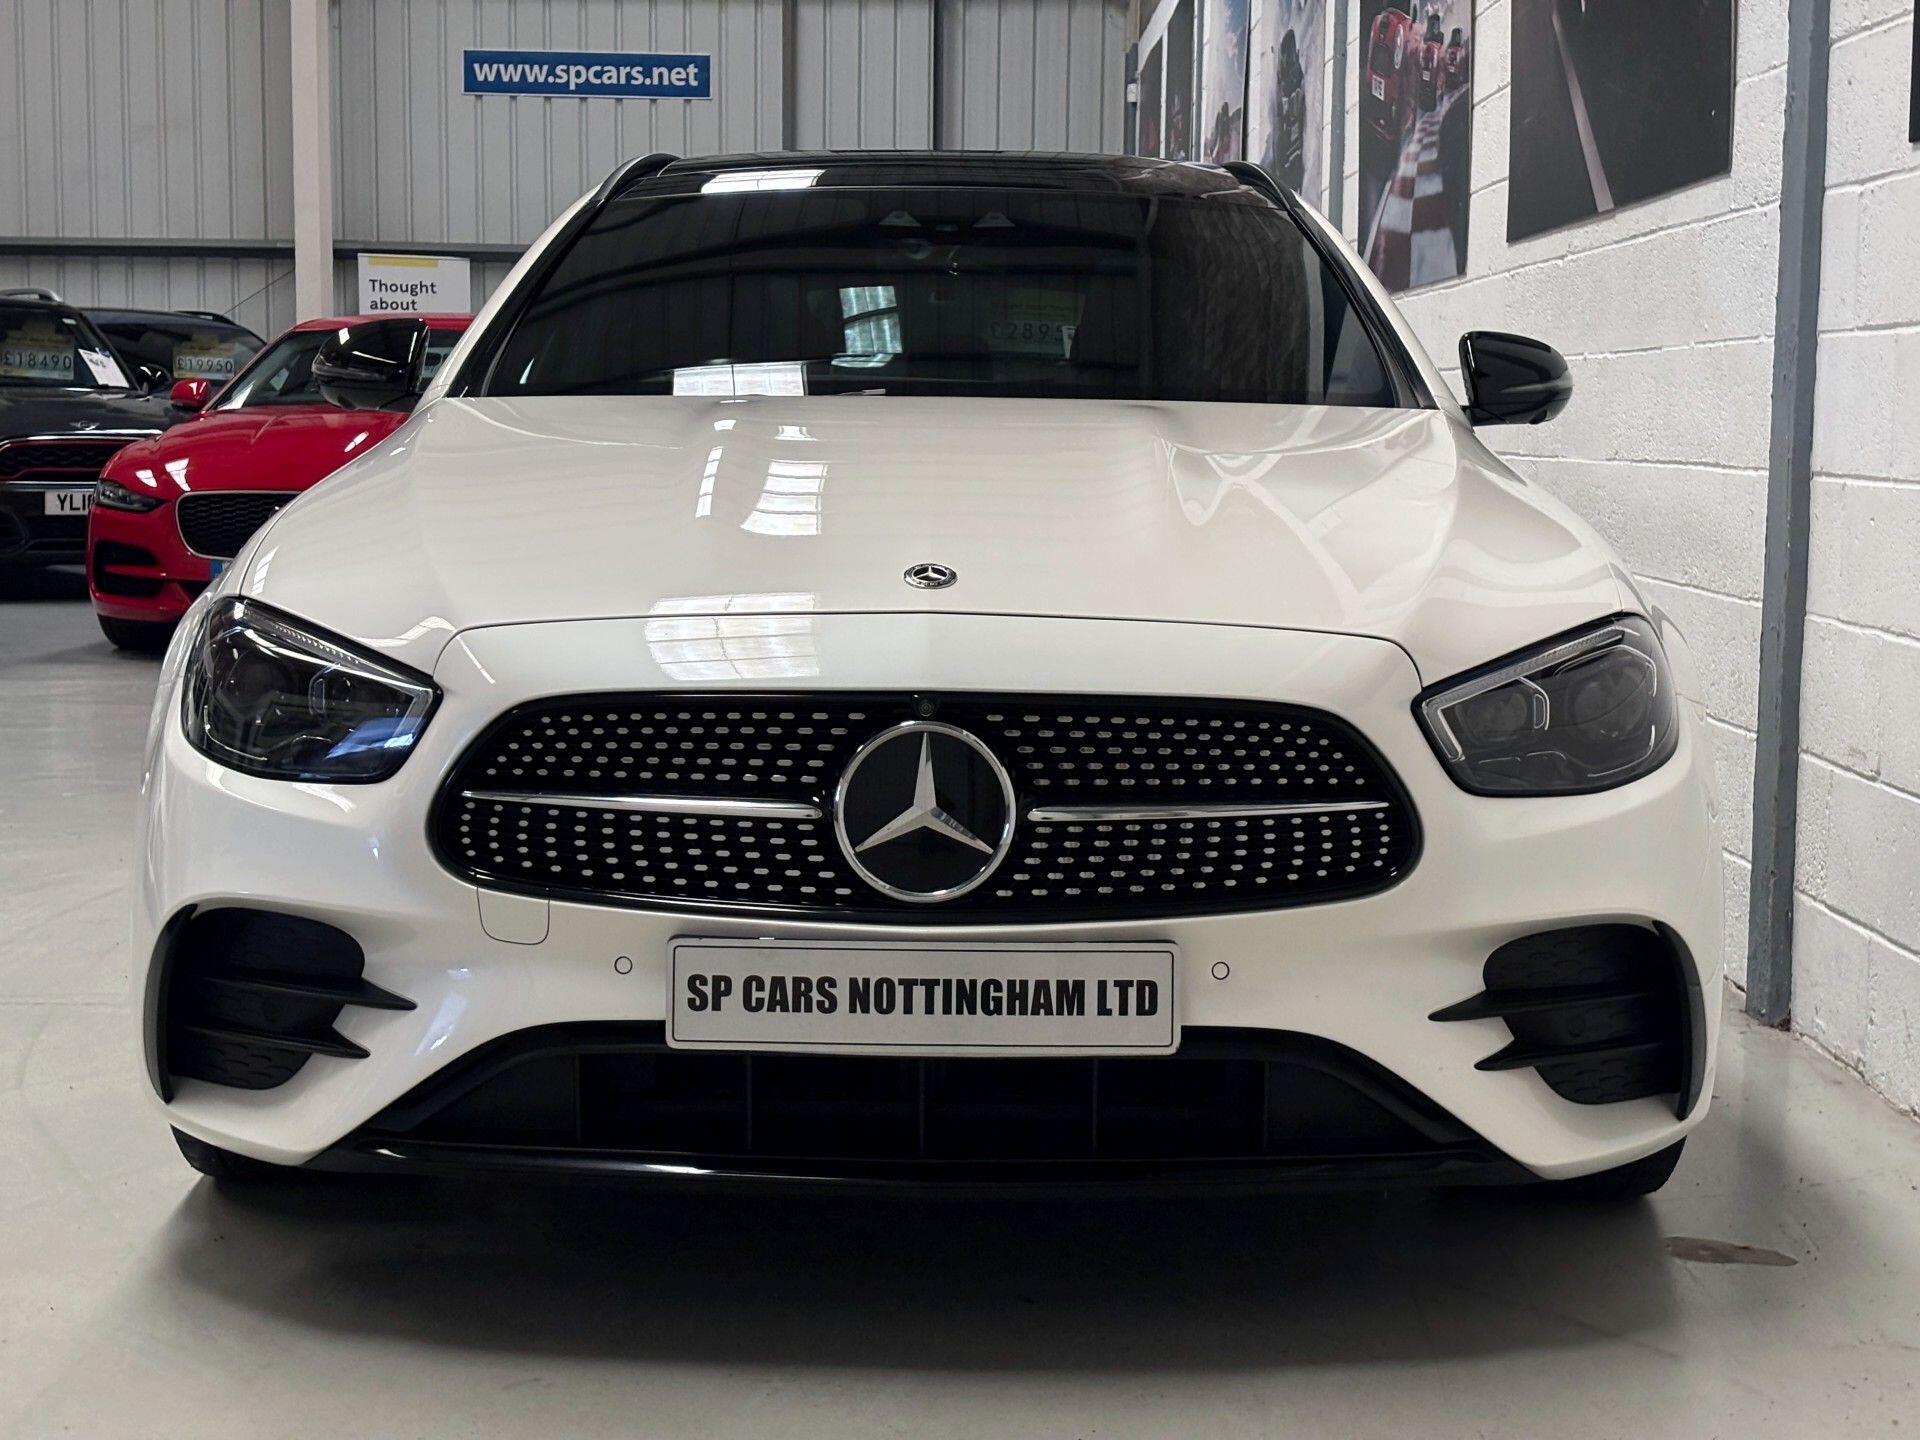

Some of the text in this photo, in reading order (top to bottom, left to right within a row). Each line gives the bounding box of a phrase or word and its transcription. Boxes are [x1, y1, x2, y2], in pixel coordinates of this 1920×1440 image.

[472, 62, 699, 91] www.spcars.net
[369, 279, 437, 297] Thought
[369, 297, 418, 311] about
[3, 349, 73, 370] £18490
[177, 356, 233, 373] £19950
[687, 973, 1159, 1017] SP CARS NOTTINGHAM LTD
